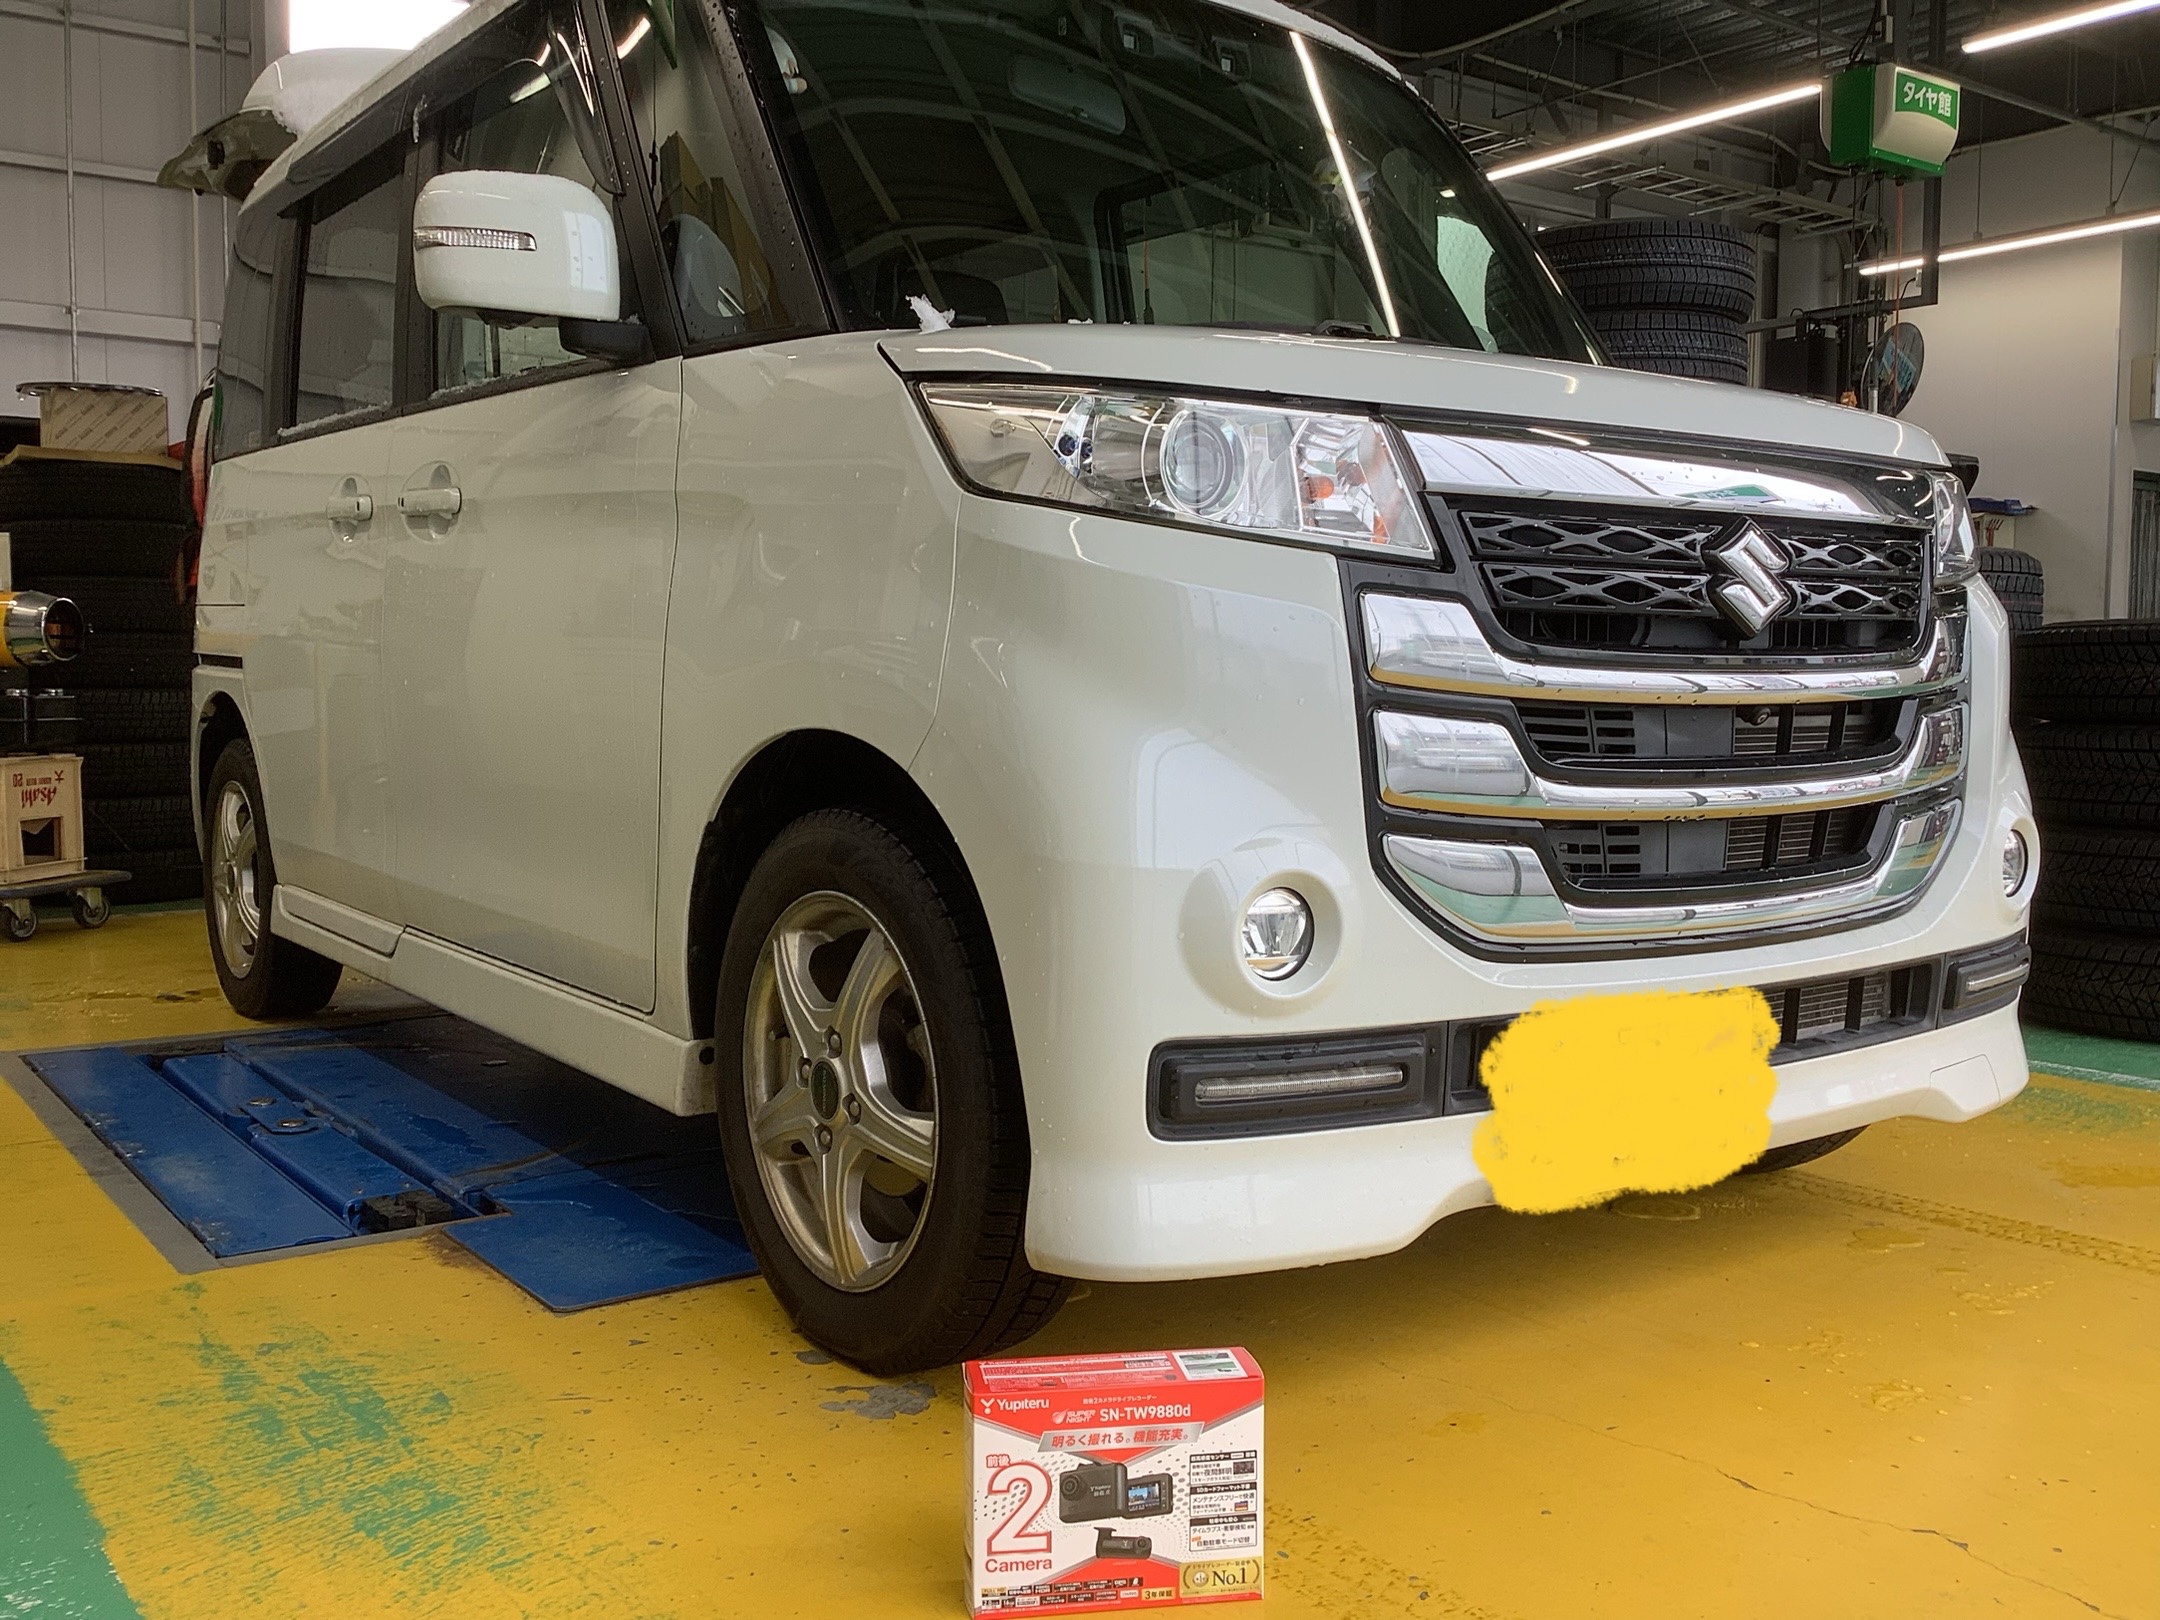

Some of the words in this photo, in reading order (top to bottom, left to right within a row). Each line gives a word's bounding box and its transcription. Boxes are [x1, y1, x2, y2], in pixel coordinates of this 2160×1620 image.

[1903, 81, 1952, 117] タイヤ館
[21, 787, 57, 809] Asahi
[996, 1398, 1050, 1413] Yupiteru
[1067, 1409, 1096, 1417] SUPER
[1100, 1404, 1191, 1422] SN-TW9880d
[1066, 1416, 1091, 1424] NIGHT
[986, 1454, 1011, 1468] 前後
[987, 1461, 1052, 1556] 2
[985, 1558, 1052, 1573] Camera
[1212, 1567, 1246, 1586] No.1
[1145, 1589, 1173, 1600] 3年保証
